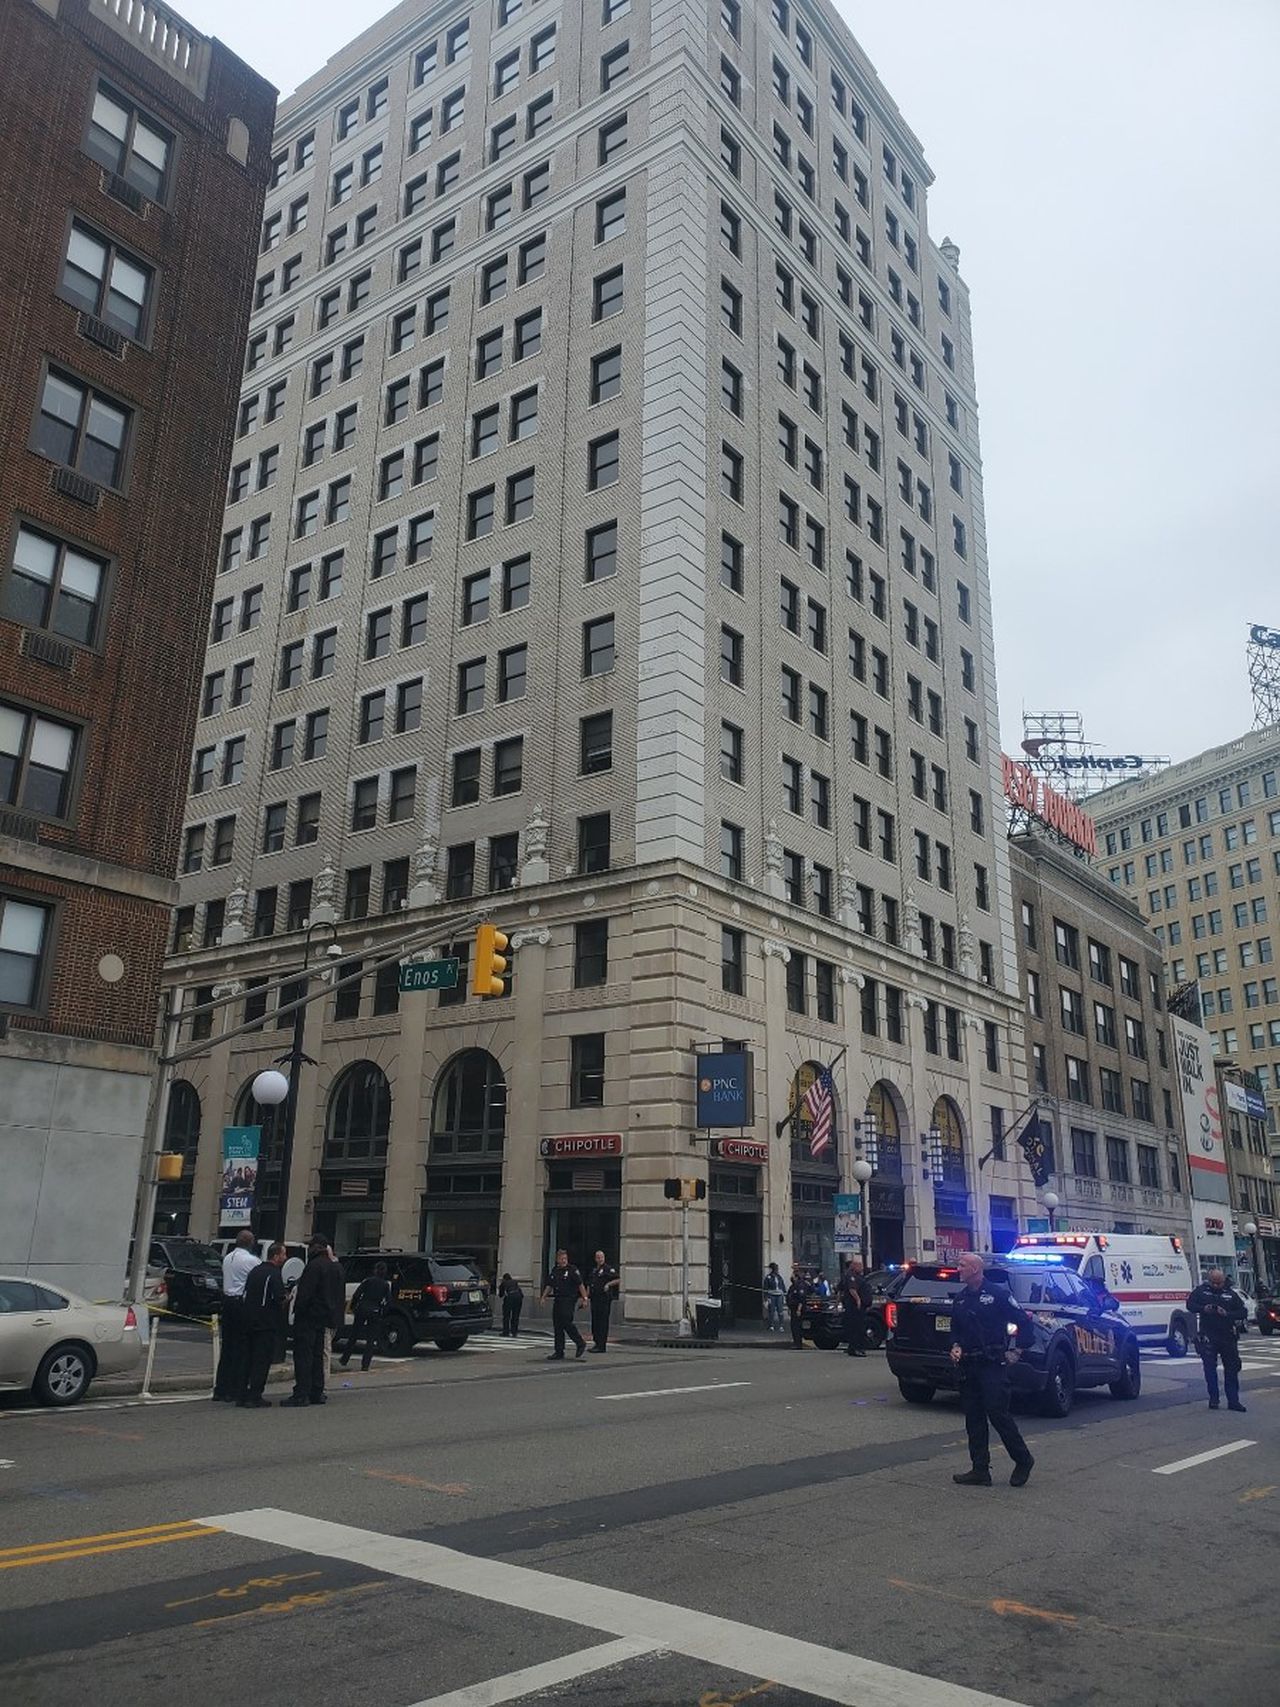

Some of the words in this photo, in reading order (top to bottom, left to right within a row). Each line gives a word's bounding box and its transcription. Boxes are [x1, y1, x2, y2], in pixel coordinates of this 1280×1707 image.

[404, 968, 439, 986] Enos
[713, 1077, 737, 1089] PNC
[713, 1090, 743, 1102] BANK
[555, 1138, 615, 1152] CHIPOTLE
